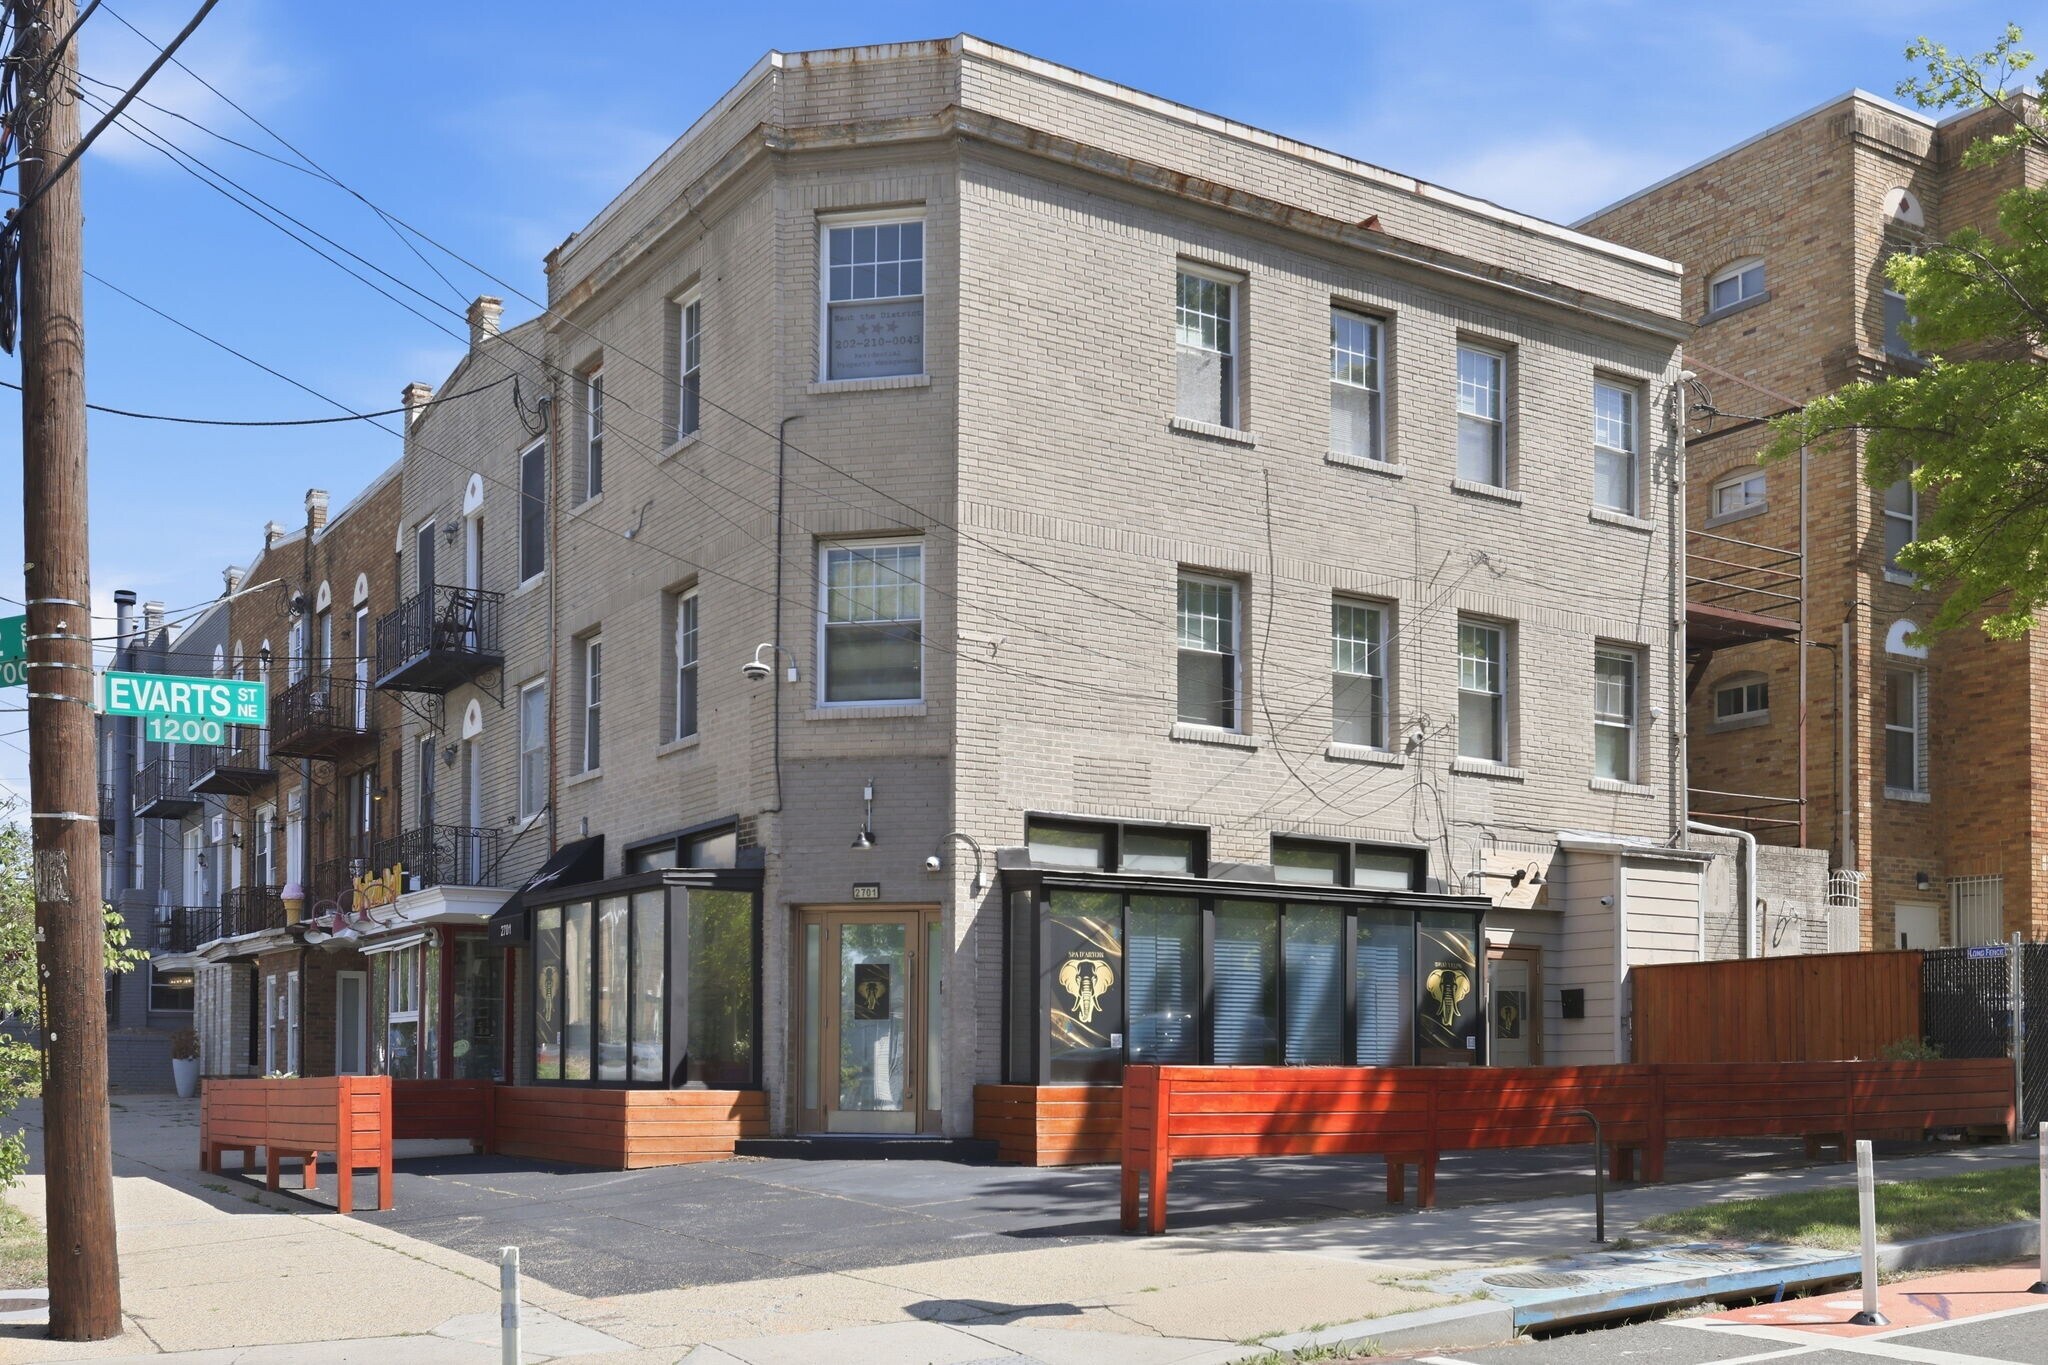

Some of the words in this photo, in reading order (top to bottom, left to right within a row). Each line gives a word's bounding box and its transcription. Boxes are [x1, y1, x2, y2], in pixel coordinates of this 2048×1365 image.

[860, 312, 876, 320] the
[835, 334, 921, 350] 202-210-0043
[20, 622, 27, 637] S
[0, 660, 28, 684] 00
[110, 677, 232, 718] EVARTS
[237, 687, 258, 702] ST
[237, 703, 258, 718] NE
[149, 718, 221, 743] 1200
[855, 888, 876, 898] 2701
[500, 923, 512, 937] 2701
